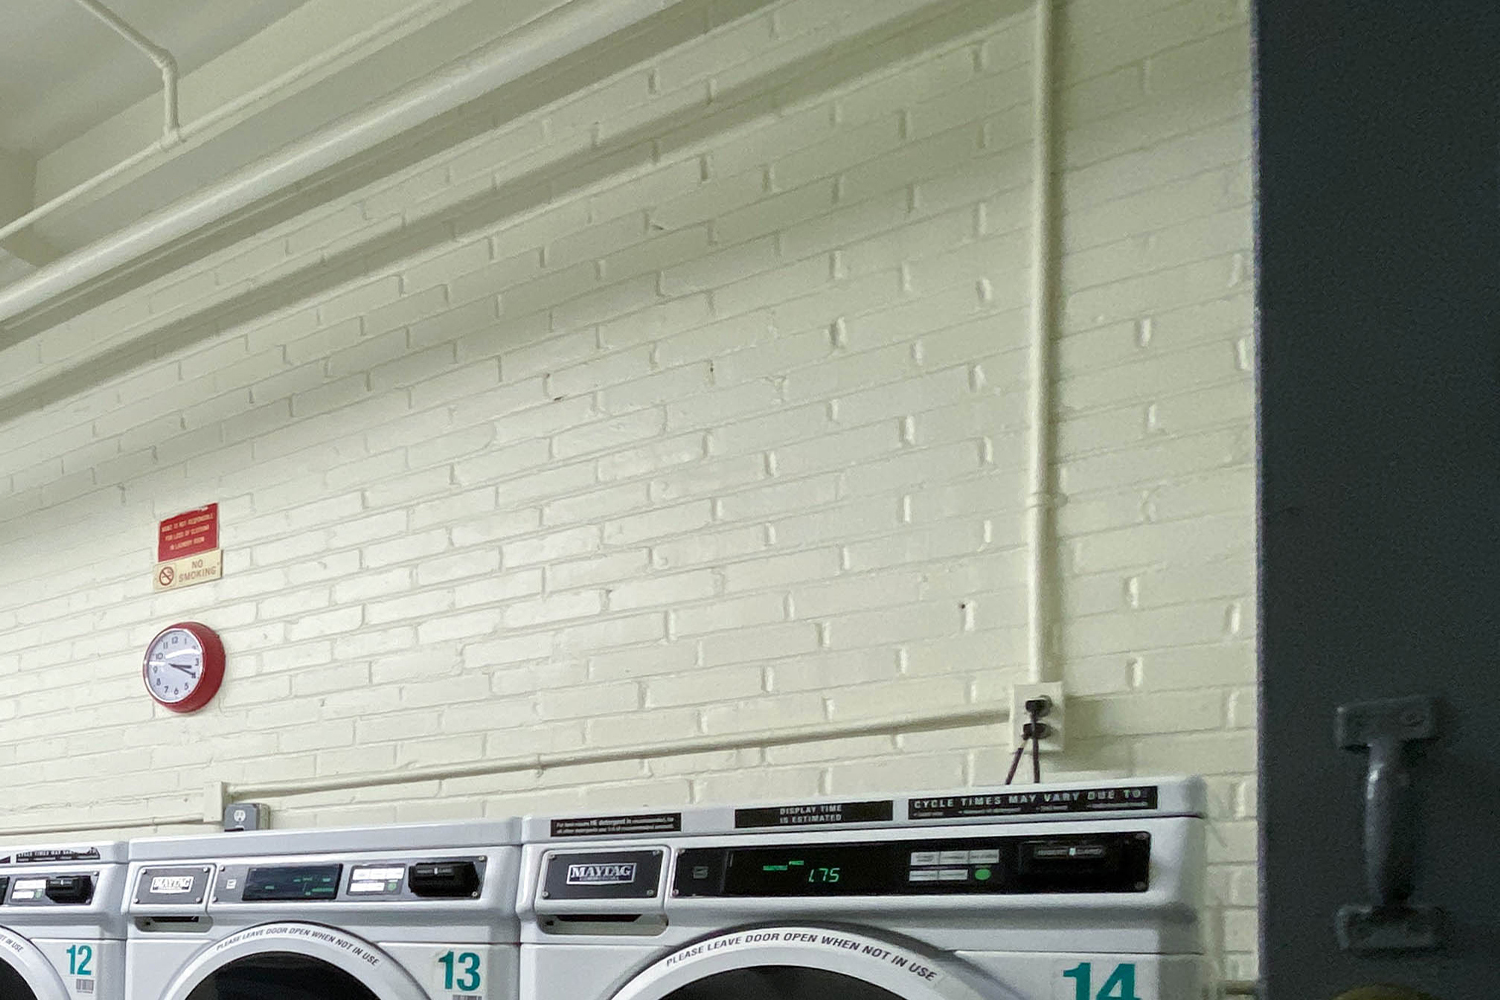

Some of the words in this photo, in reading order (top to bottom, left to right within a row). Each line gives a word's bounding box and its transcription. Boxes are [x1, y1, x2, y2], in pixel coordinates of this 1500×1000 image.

[192, 559, 203, 569] NO
[179, 566, 216, 582] SMOKING
[914, 798, 954, 810] CYCLE
[960, 795, 1002, 808] TIMES
[1008, 793, 1037, 805] MAY
[1044, 791, 1081, 803] VARY
[1087, 789, 1115, 800] DUE
[779, 805, 817, 815] DISPLAY
[820, 804, 842, 814] TIME
[779, 816, 789, 824] IS
[791, 814, 842, 824] ESTIMATED
[571, 865, 632, 878] MAYTAG
[242, 929, 264, 940] LEAVE
[265, 927, 288, 935] DOOR
[289, 927, 310, 936] OPEN
[311, 931, 335, 943] WHEN
[335, 938, 353, 950] NOT
[352, 946, 362, 956] IN
[362, 951, 381, 967] USE
[66, 944, 92, 976] 12
[666, 945, 705, 967] PLEASE
[707, 936, 742, 951] LEAVE
[745, 932, 780, 944] DOOR
[783, 932, 818, 943] OPEN
[821, 935, 861, 951] WHEN
[862, 944, 890, 960] NOT
[891, 953, 908, 968] IN
[909, 961, 938, 982] USE
[437, 951, 481, 992] 13
